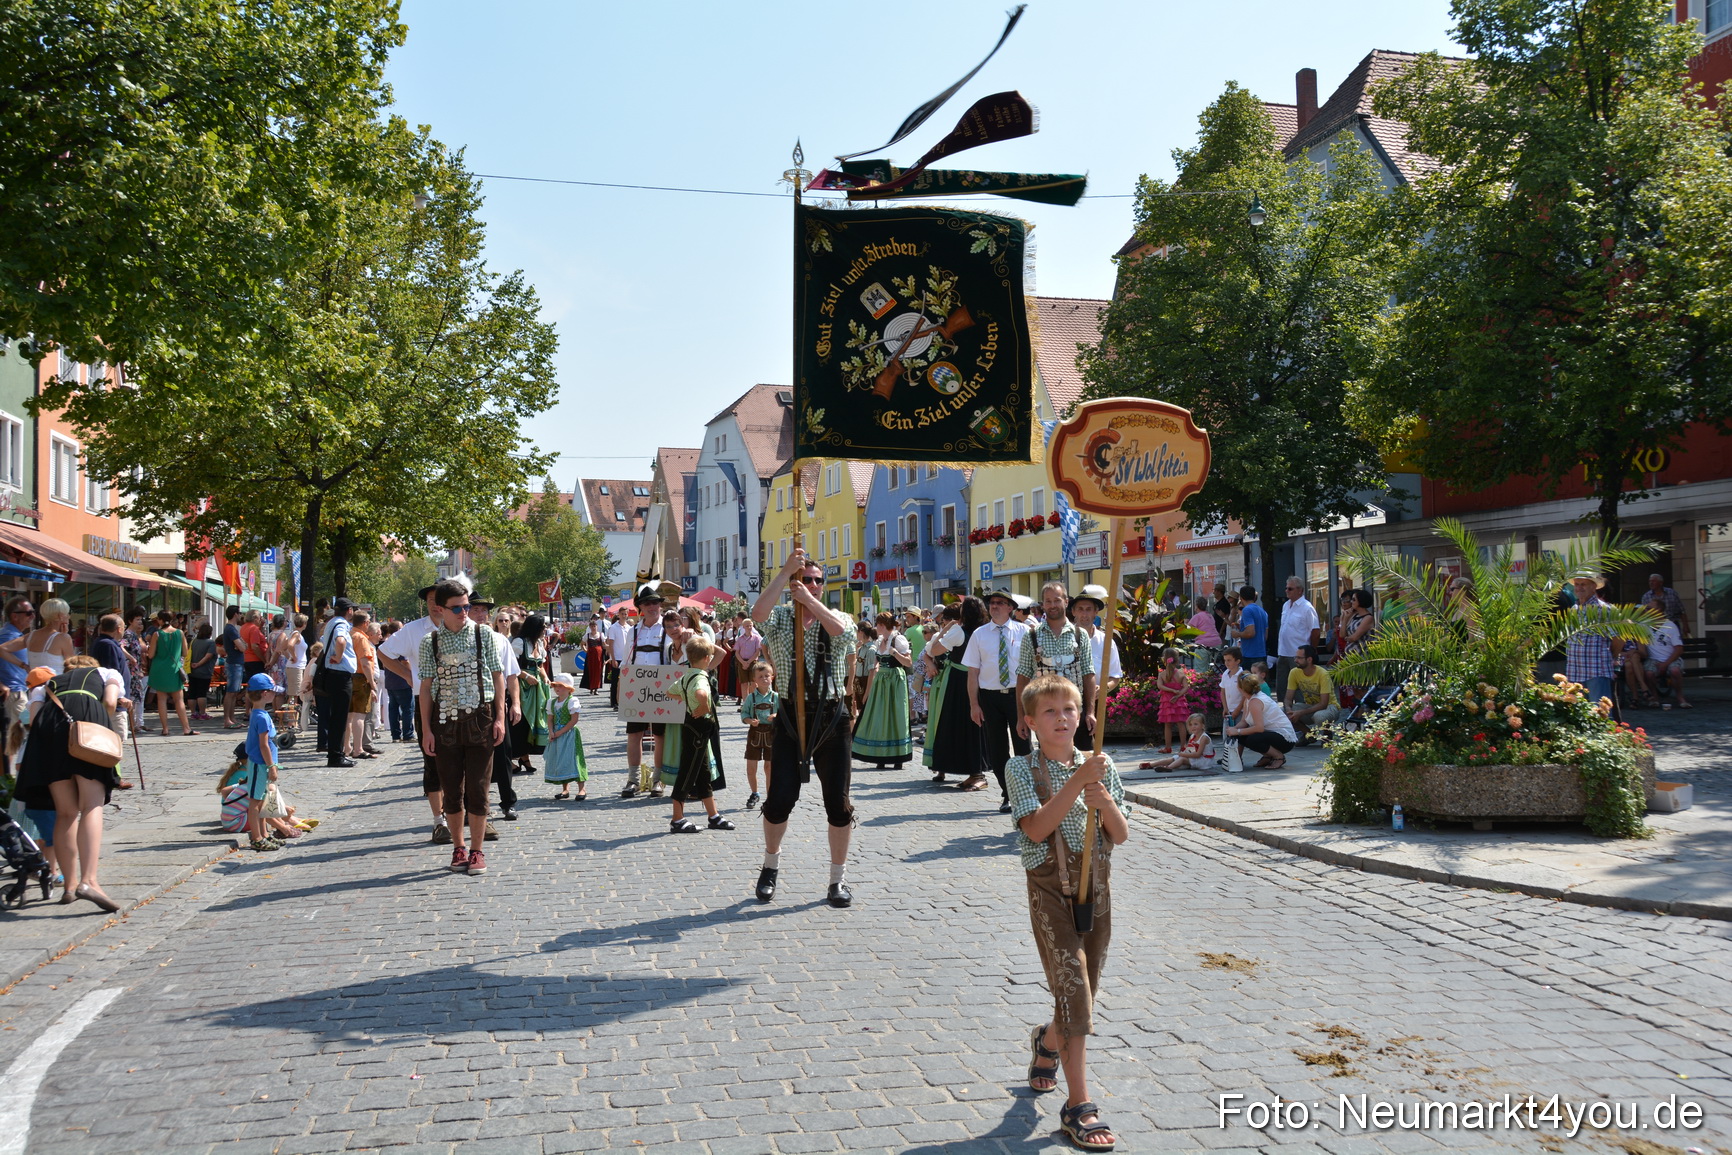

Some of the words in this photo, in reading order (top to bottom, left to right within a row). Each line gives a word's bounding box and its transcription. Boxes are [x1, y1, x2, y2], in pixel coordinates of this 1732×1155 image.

[863, 237, 917, 265] Streben
[820, 283, 845, 318] Ziel
[815, 323, 833, 357] Gut
[881, 410, 914, 431] Ein
[914, 400, 951, 428] Ziel
[976, 321, 999, 372] Leben
[1134, 442, 1189, 484] Wolfstein
[88, 534, 107, 556] LEDER
[982, 563, 990, 578] P
[636, 668, 659, 679] Grod
